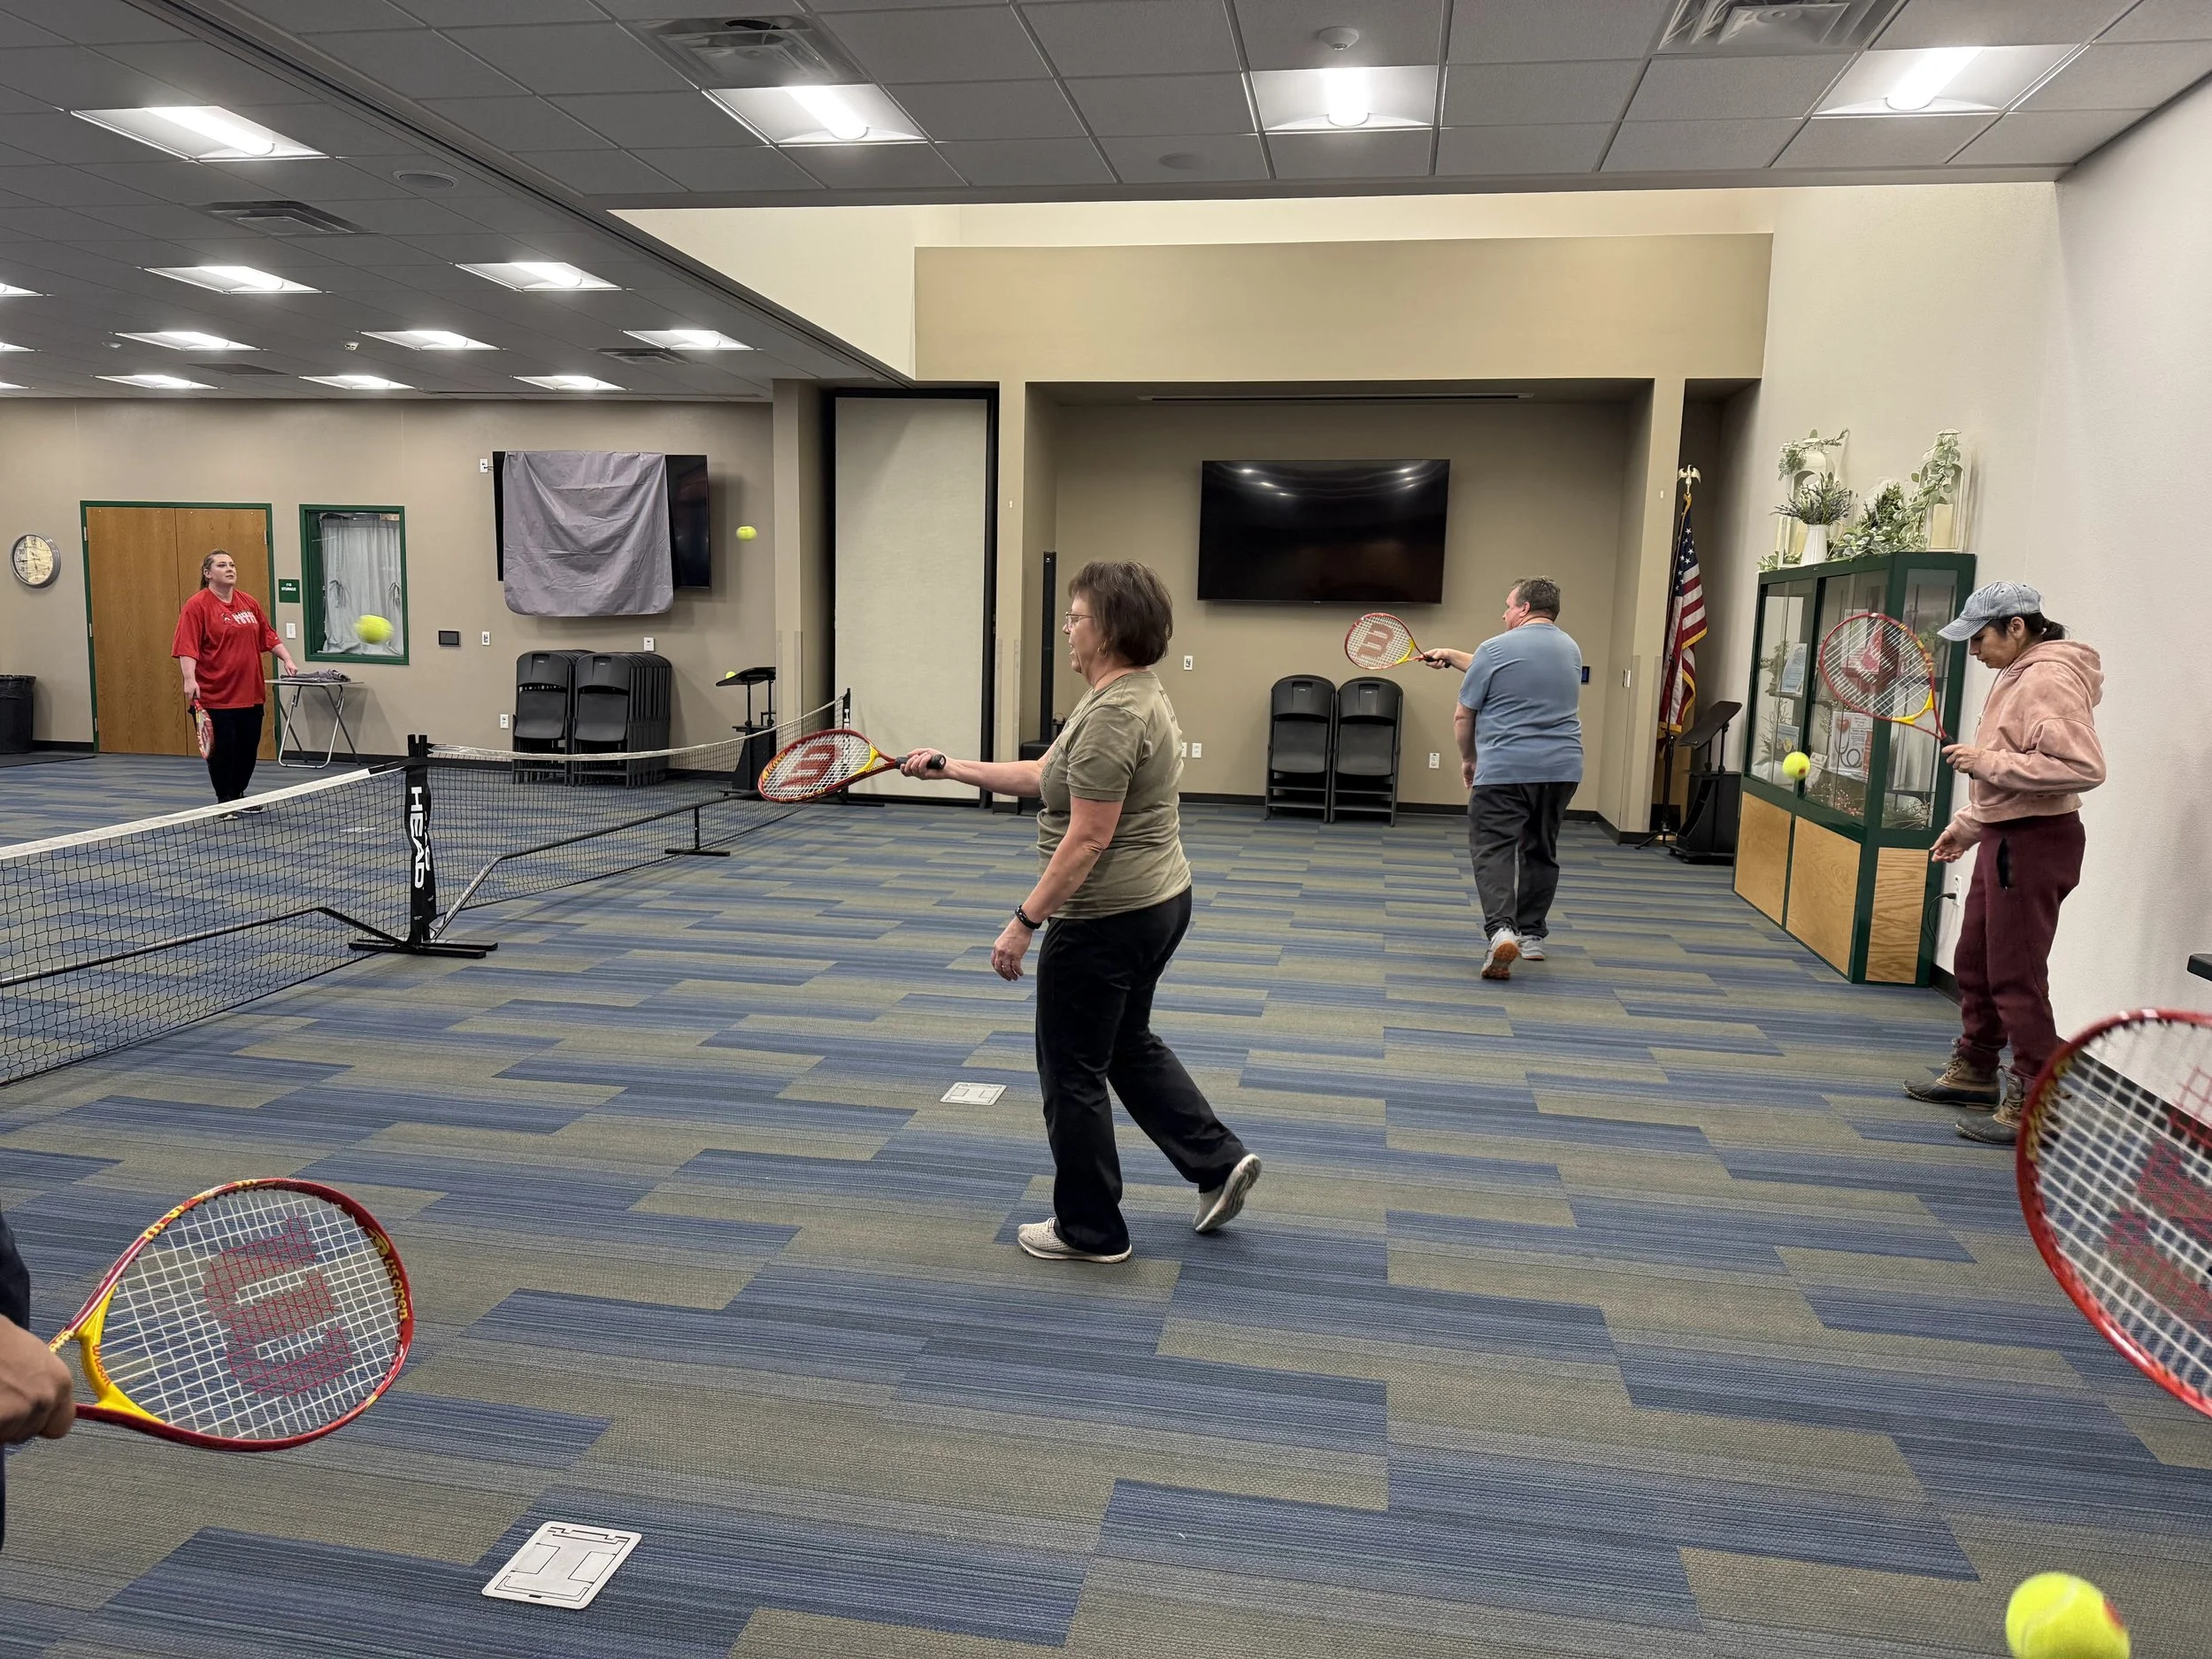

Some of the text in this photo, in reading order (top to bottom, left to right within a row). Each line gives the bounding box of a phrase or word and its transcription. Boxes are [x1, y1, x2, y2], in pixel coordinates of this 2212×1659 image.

[410, 787, 425, 888] HEAD
[204, 1216, 353, 1397] W
[92, 1345, 111, 1386] Wilson
